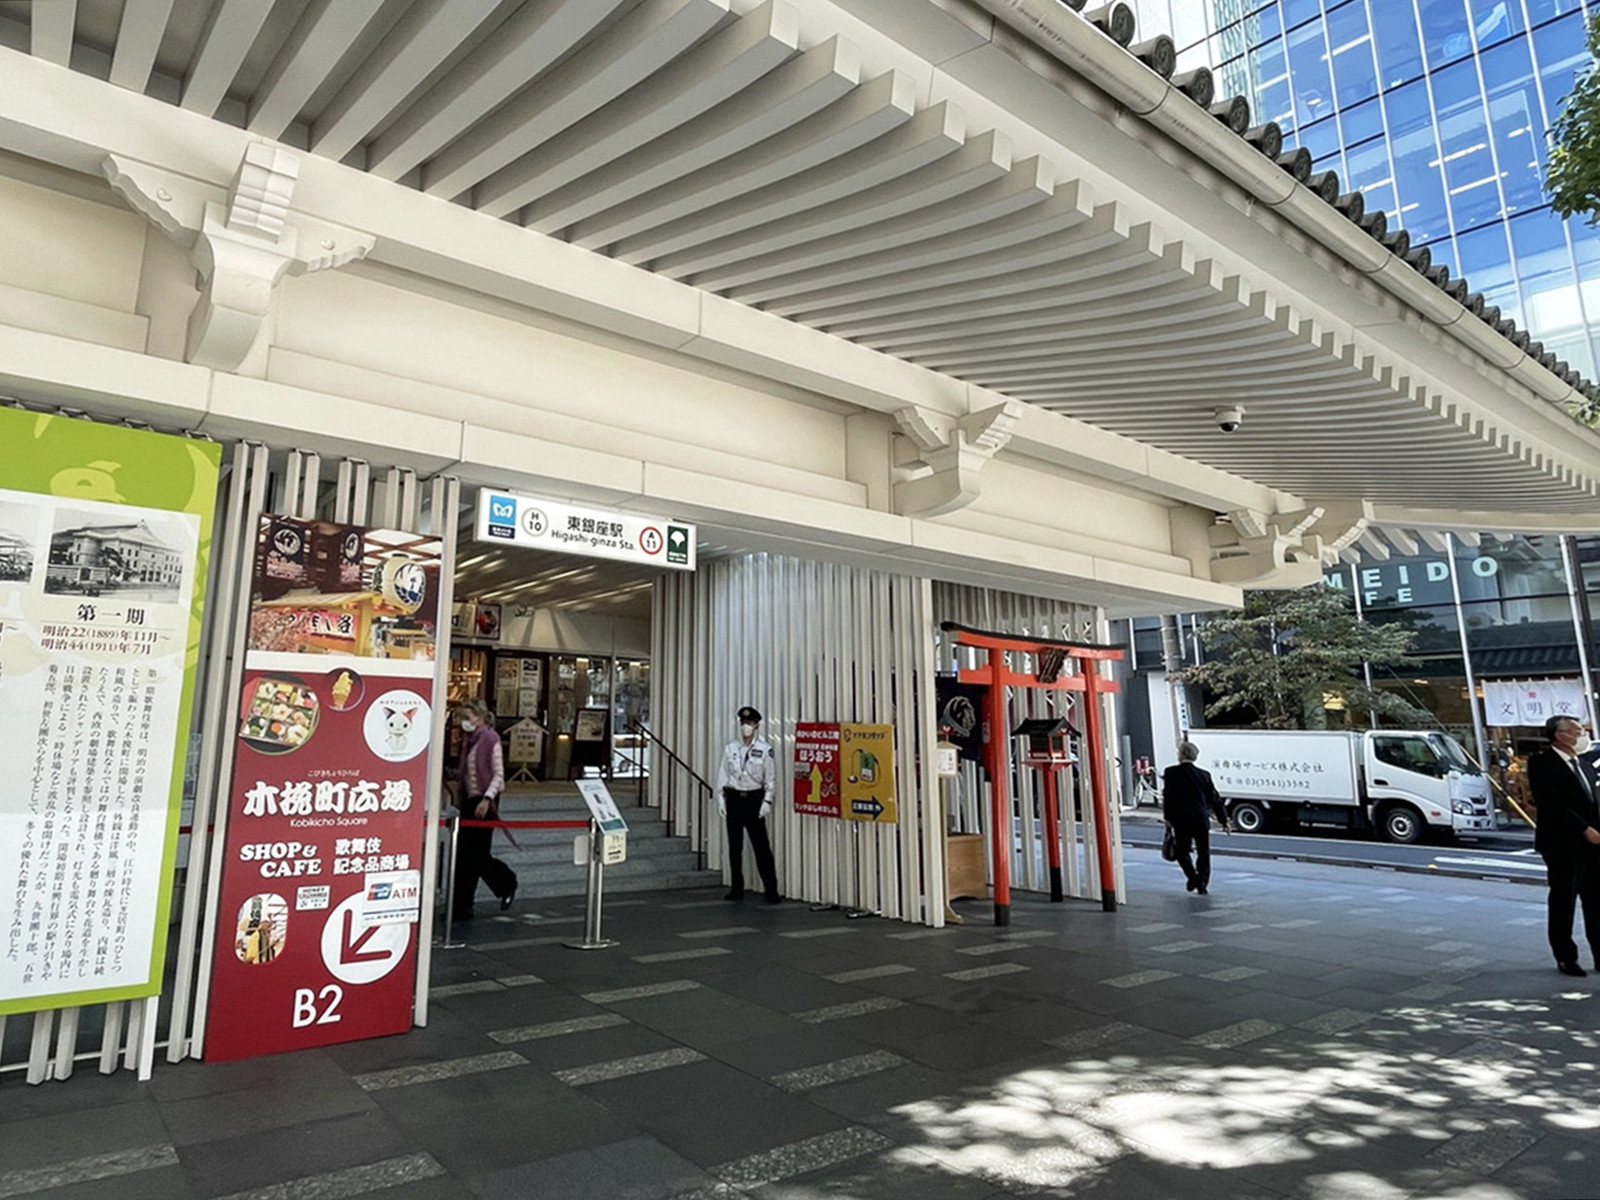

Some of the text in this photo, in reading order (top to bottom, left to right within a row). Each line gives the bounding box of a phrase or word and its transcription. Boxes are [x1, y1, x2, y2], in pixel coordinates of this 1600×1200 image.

[530, 512, 539, 520] H
[529, 521, 542, 531] 10
[567, 516, 624, 537] 東銀座駅
[551, 530, 618, 549] Higashi-ginza
[646, 540, 657, 549] 11
[77, 603, 145, 625] 第一期
[1500, 701, 1572, 716] 文明堂
[800, 750, 833, 763] ほうおう
[243, 779, 412, 817] 木挽町広場
[290, 815, 368, 828] Kobikicho Square
[335, 838, 382, 855] 歌舞伎
[260, 859, 322, 878] CAFE
[333, 854, 410, 875] 記念品商場
[392, 887, 418, 899] ATM
[293, 984, 343, 1028] B2
